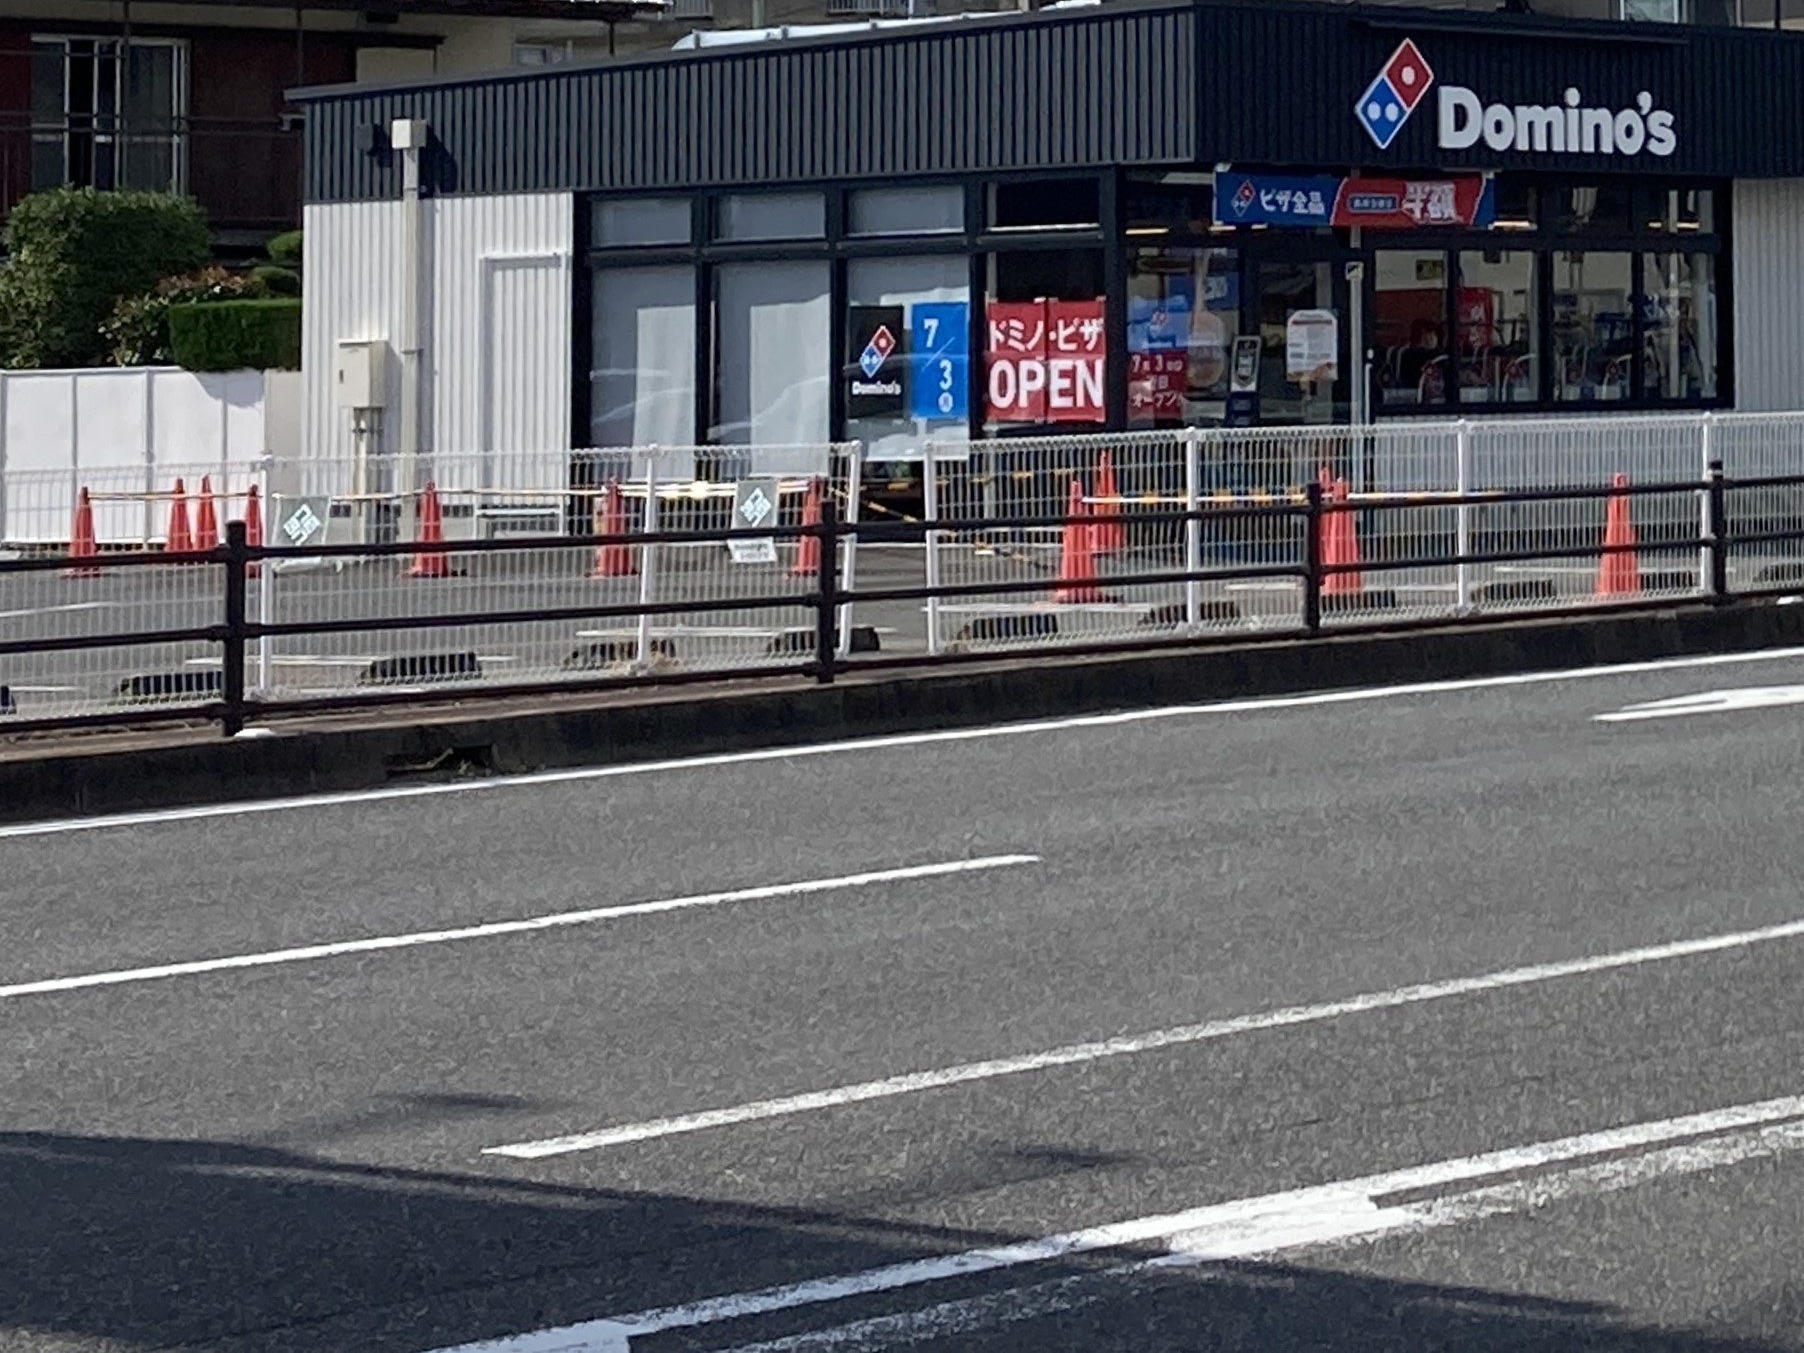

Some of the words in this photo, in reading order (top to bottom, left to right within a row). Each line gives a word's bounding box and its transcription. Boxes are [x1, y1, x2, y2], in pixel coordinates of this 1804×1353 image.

[1438, 85, 1677, 156] Domino's
[1259, 188, 1326, 216] ピザ全品
[989, 317, 1104, 353] ドミノ・ピザ
[989, 358, 1104, 409] OPEN
